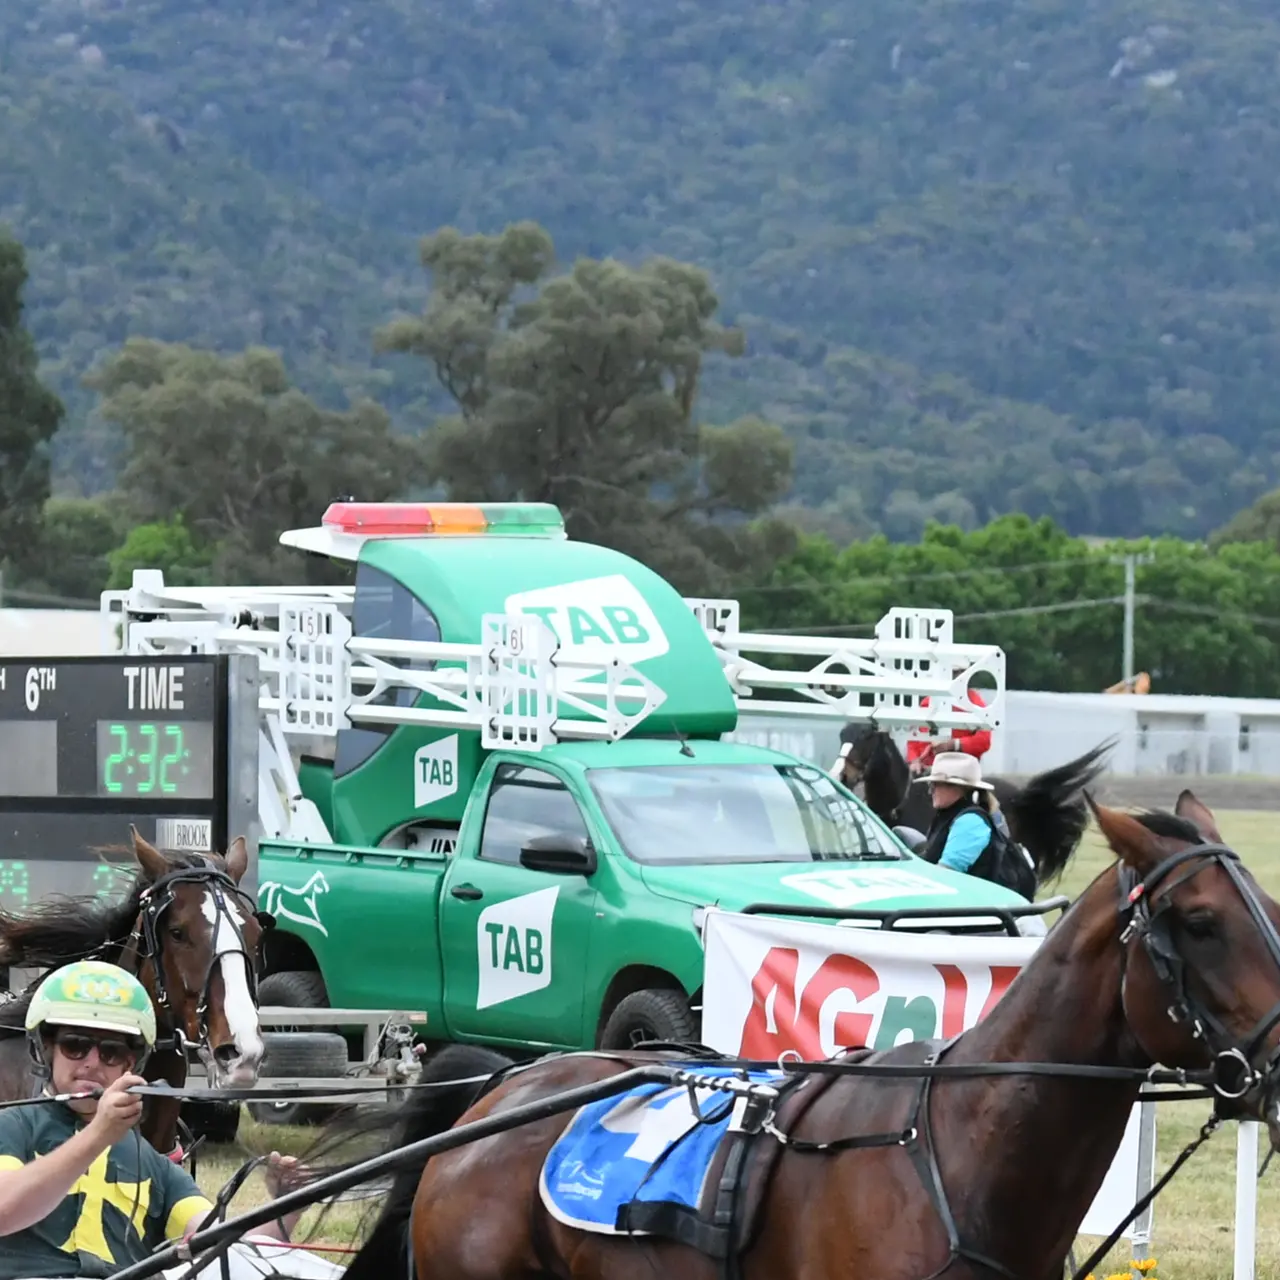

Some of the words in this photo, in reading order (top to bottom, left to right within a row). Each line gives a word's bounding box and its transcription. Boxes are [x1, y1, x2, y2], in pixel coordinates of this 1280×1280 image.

[510, 629, 518, 650] 6
[521, 606, 650, 646] TAB
[25, 668, 56, 711] 6TH
[123, 667, 184, 709] TIME
[419, 757, 453, 786] TAB
[176, 824, 209, 847] BROOK
[485, 922, 544, 975] TAB
